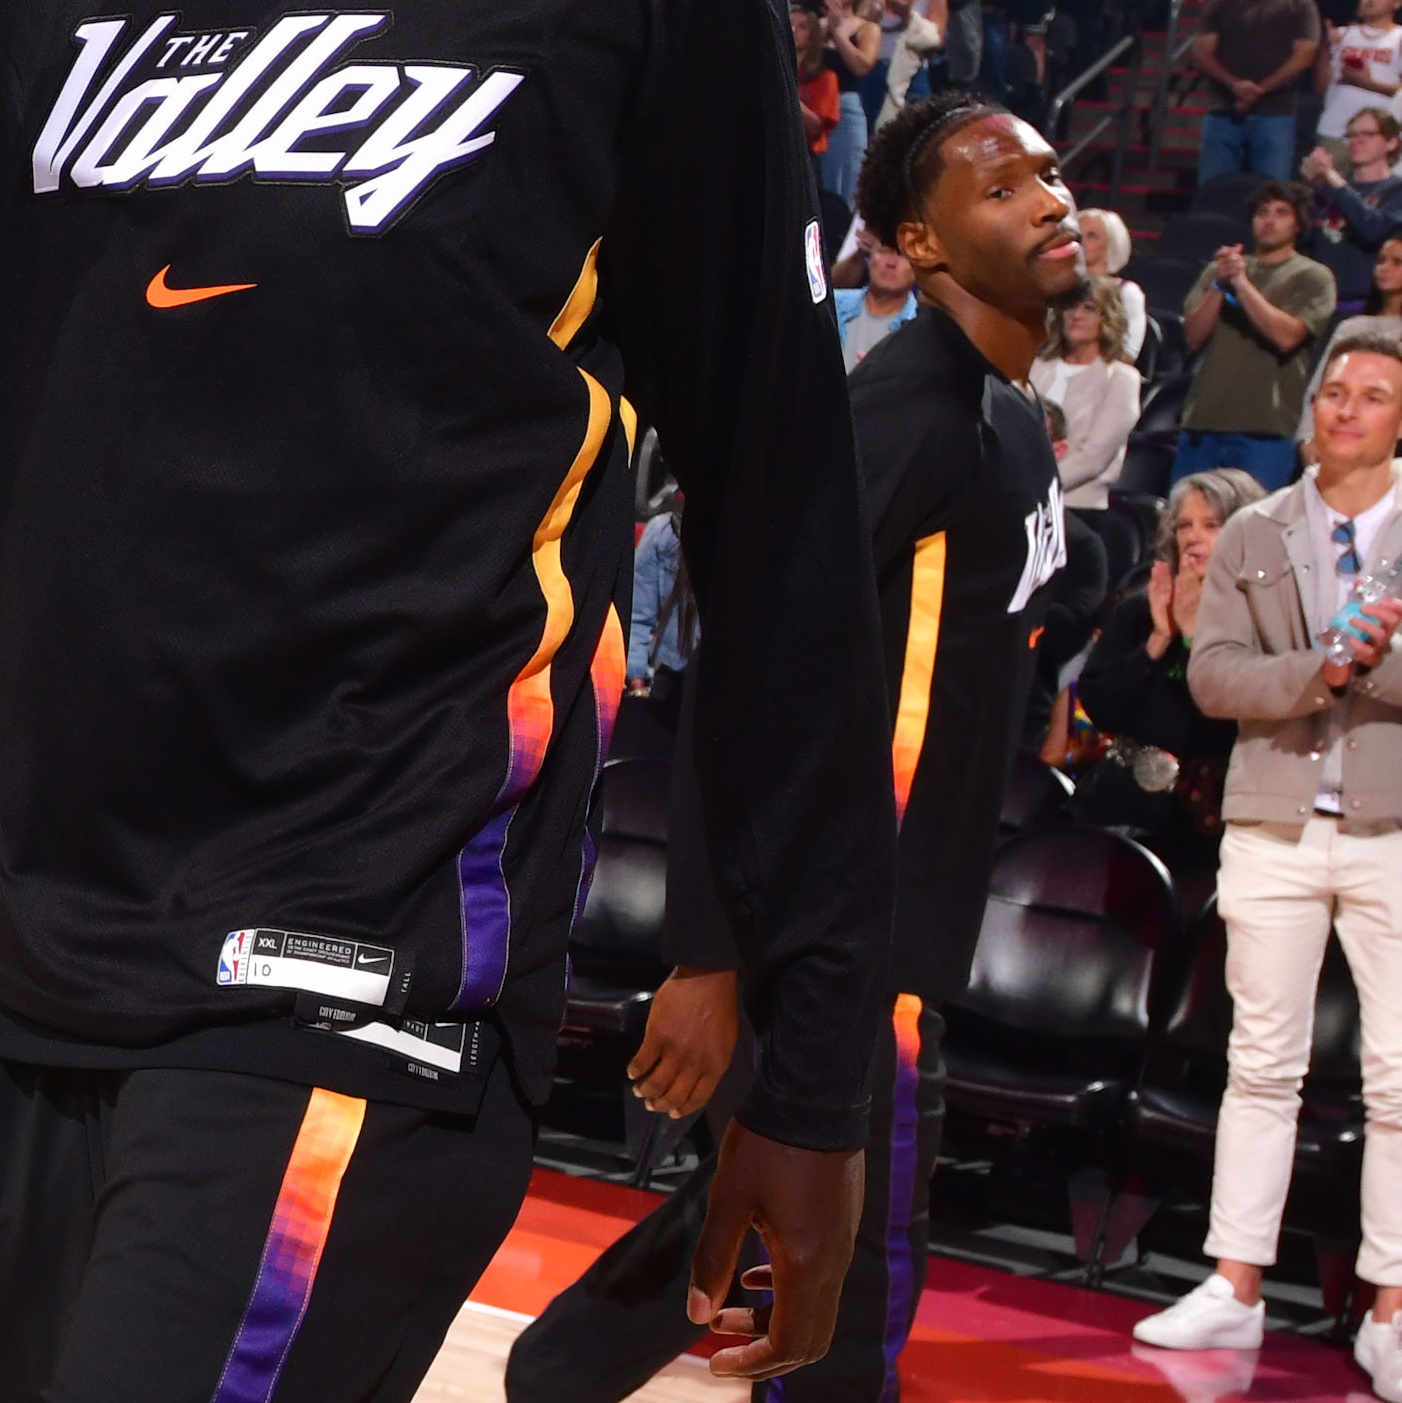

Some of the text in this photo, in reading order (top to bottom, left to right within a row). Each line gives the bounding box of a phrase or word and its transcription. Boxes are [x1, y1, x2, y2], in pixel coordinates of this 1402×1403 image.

[155, 31, 249, 69] THE
[32, 14, 526, 235] Valley
[257, 937, 277, 949] XXL
[287, 938, 352, 954] ENGINEERED
[400, 972, 411, 993] TALL
